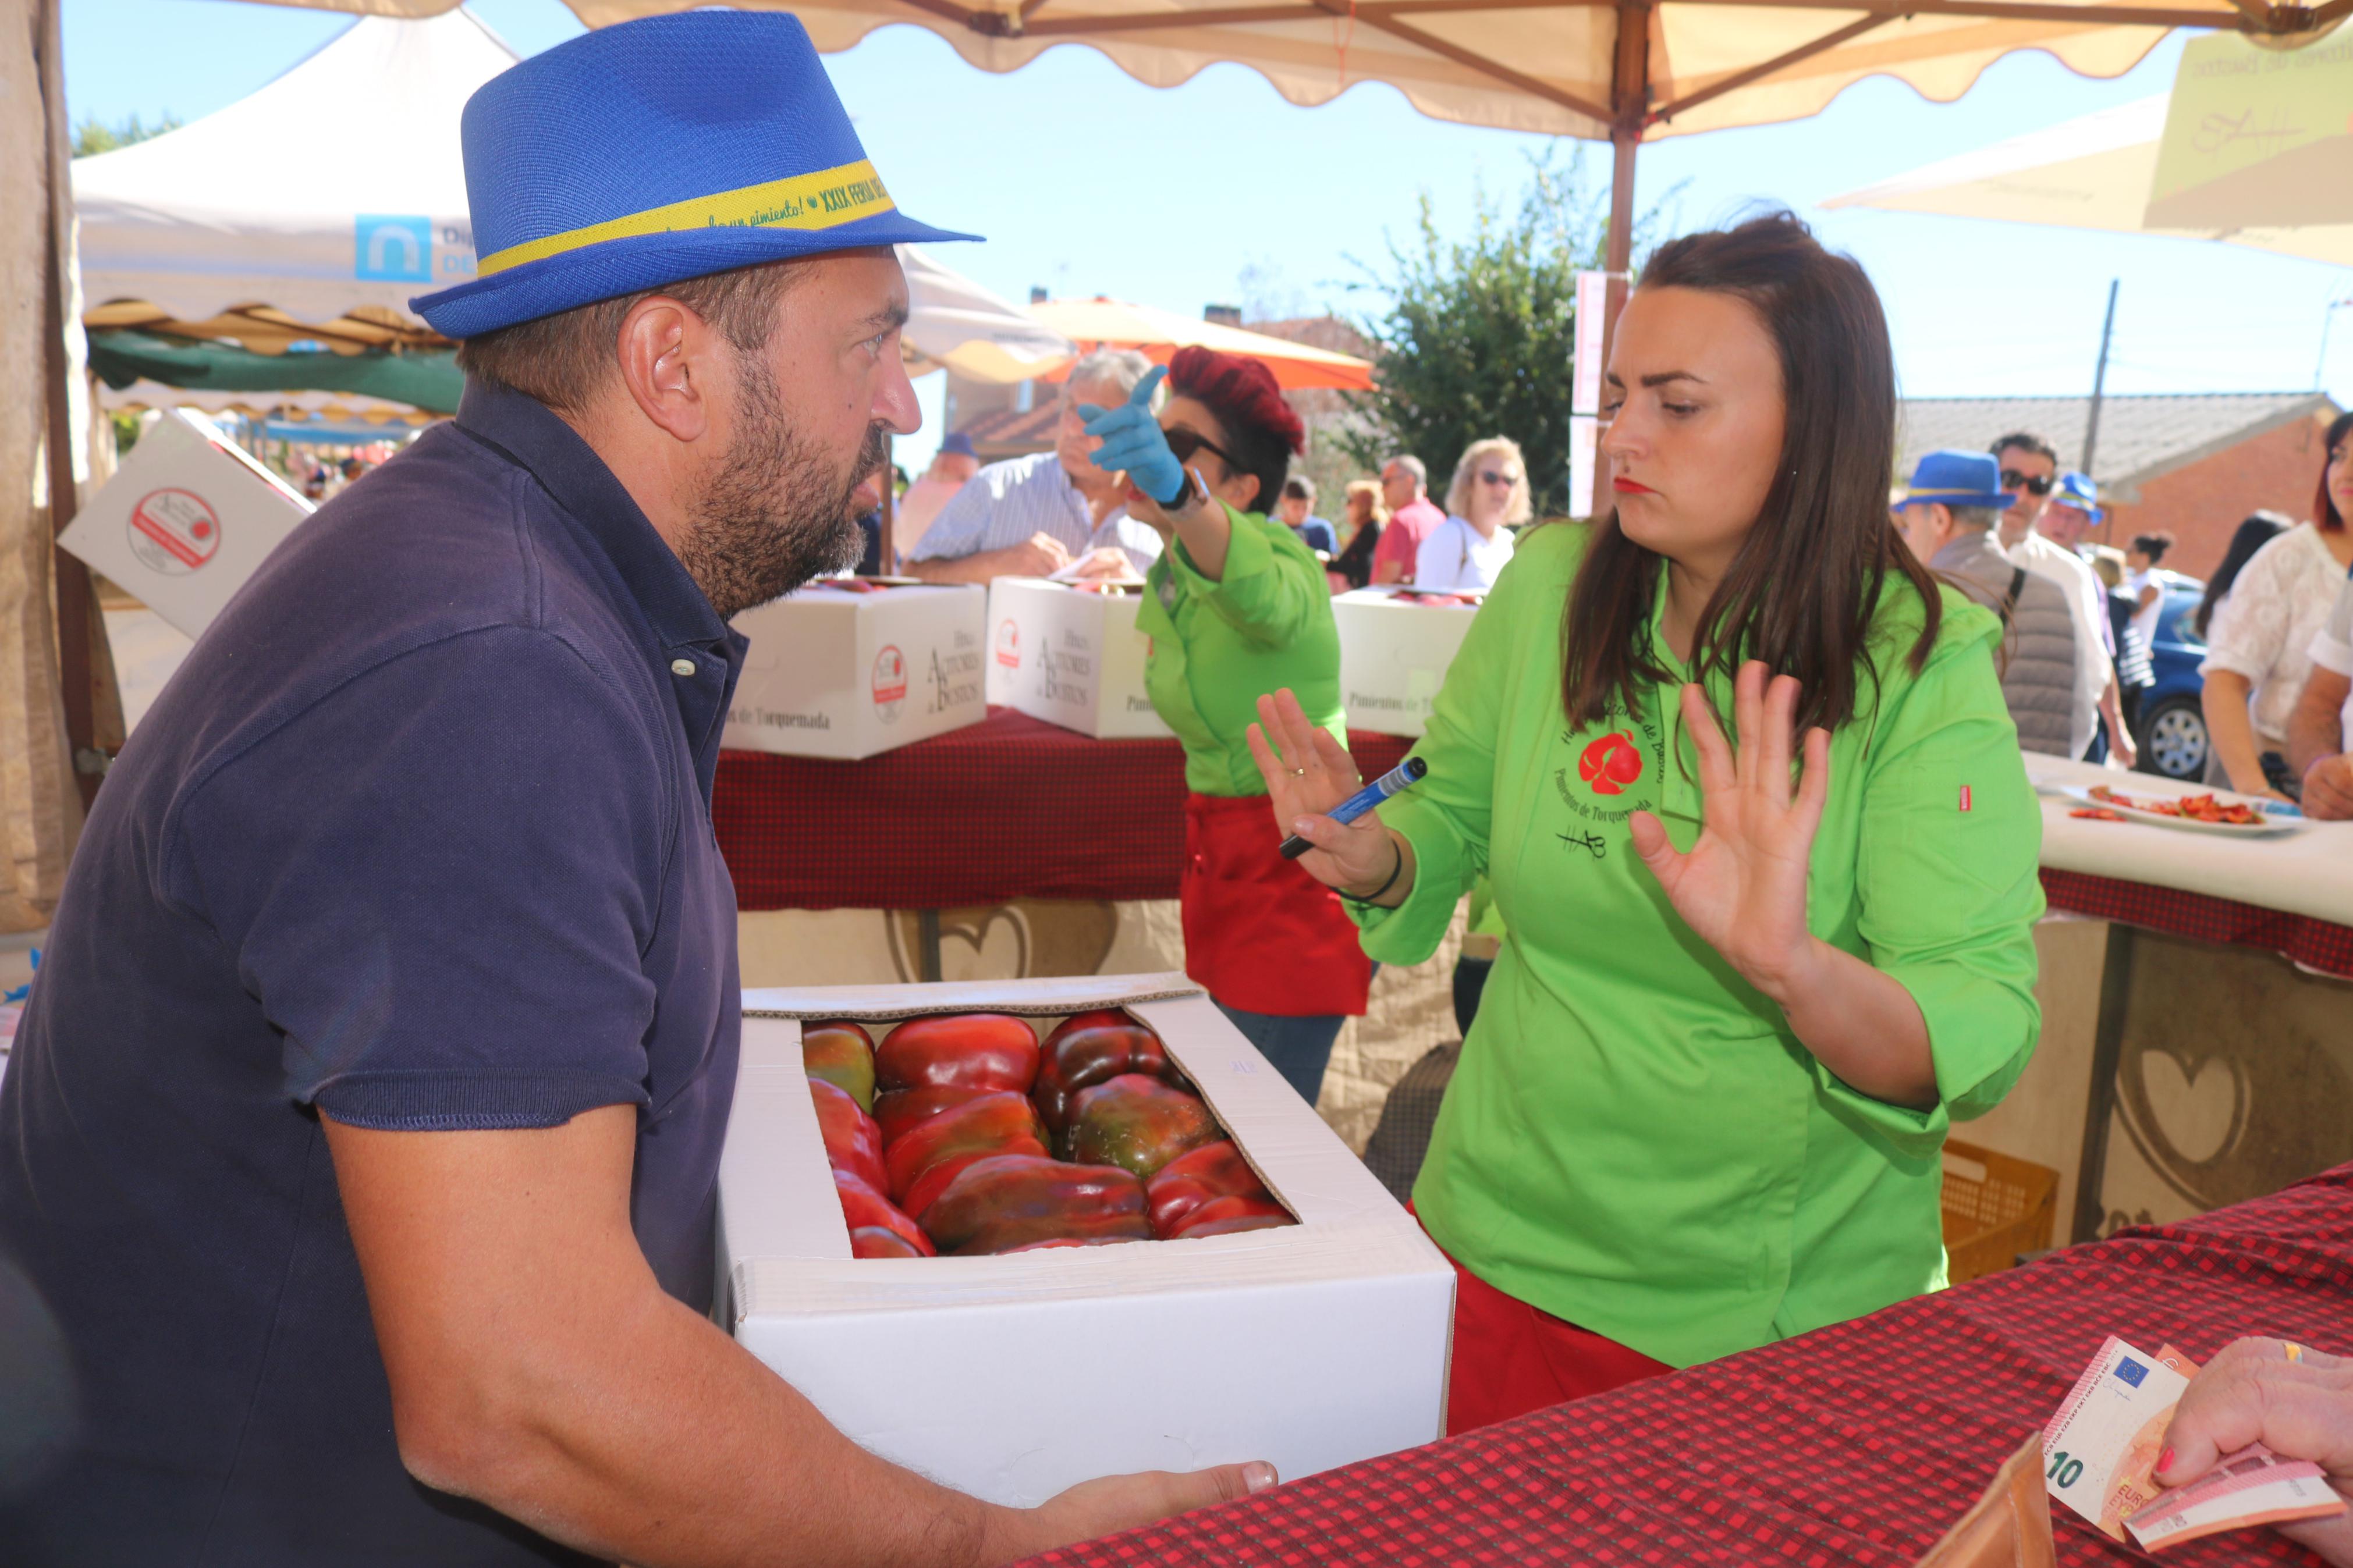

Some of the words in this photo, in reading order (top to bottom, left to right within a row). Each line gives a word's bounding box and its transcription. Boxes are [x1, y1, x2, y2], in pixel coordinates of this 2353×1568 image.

[819, 186, 852, 212] XXIX
[1349, 692, 1403, 710] Pimientos
[755, 706, 831, 730] Torquemada
[1642, 724, 1656, 739] de
[1555, 768, 1580, 812] Pimientos
[1579, 803, 1590, 819] de
[2070, 1409, 2078, 1421] EKP
[2046, 1451, 2084, 1489] 10
